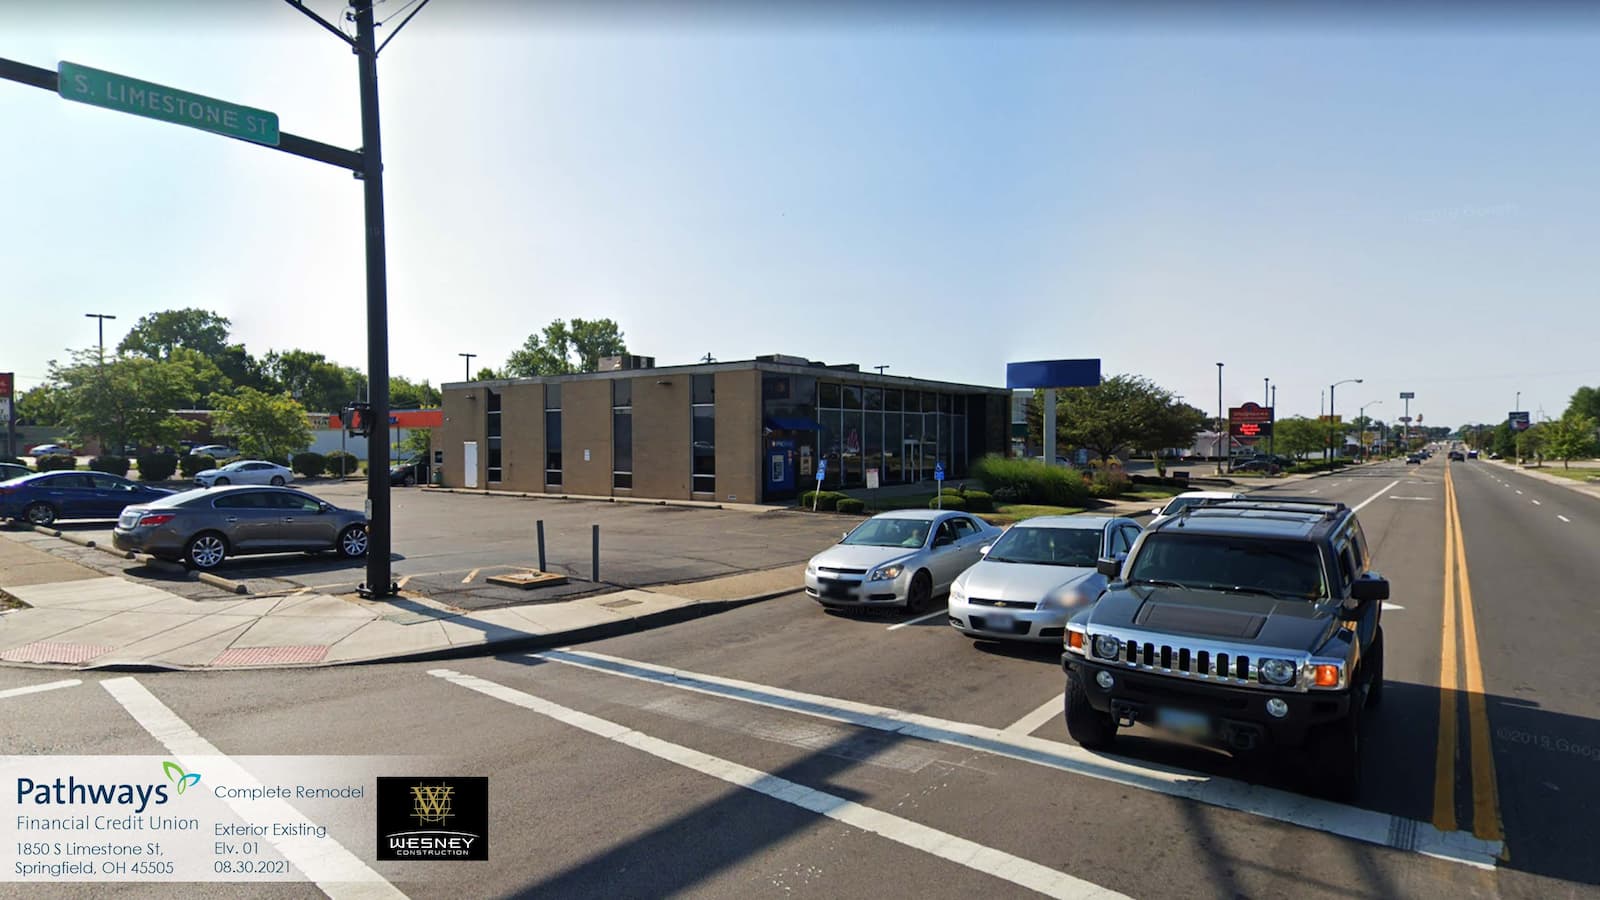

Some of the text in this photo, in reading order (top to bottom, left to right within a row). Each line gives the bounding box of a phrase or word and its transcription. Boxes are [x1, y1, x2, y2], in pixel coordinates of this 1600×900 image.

[74, 73, 268, 135] S. LIMESTONE ST
